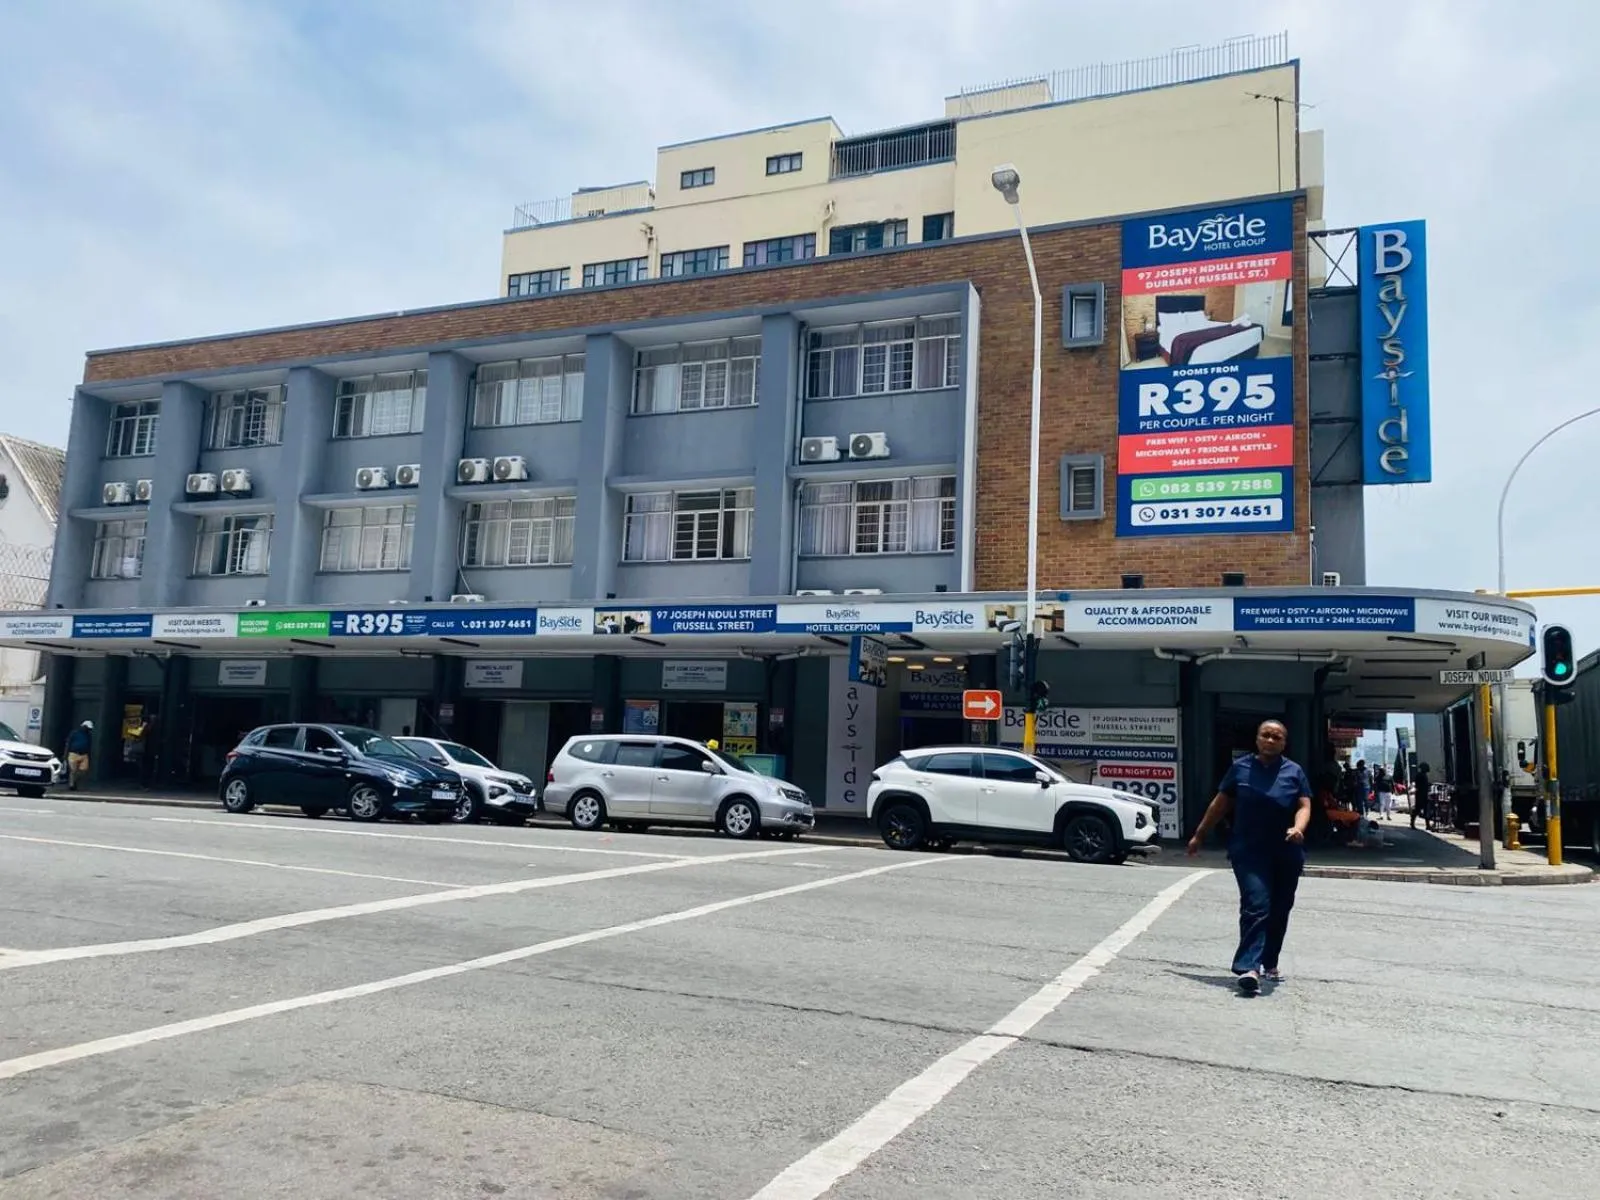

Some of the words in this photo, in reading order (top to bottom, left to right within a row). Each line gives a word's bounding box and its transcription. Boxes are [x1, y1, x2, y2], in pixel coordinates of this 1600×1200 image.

[1149, 214, 1266, 252] Bayside
[1204, 242, 1231, 251] HOTEL
[1234, 238, 1266, 248] GROUP
[1138, 271, 1152, 280] 97
[1154, 267, 1196, 279] JOSEPH
[1199, 263, 1234, 273] NDULI
[1236, 258, 1277, 270] STREET
[1145, 278, 1192, 289] DURBAN
[1195, 271, 1246, 285] (RUSSELL
[1248, 269, 1269, 280] ST.)
[1372, 229, 1414, 475] Bayside
[1173, 367, 1208, 377] ROOMS
[1210, 365, 1239, 375] FROM
[1138, 374, 1276, 417] R395
[1140, 420, 1160, 429] PER
[1213, 416, 1234, 425] PER
[1237, 412, 1275, 423] NIGHT
[1146, 437, 1167, 446] FREE
[1168, 436, 1188, 445] WIFI
[1195, 434, 1217, 444] DSTV
[1225, 433, 1260, 442] AIRCON
[1136, 448, 1191, 458] MICROWAVE
[1197, 445, 1230, 455] FRIDGE
[1231, 445, 1238, 454] &
[1240, 443, 1272, 453] KETTLE
[1171, 458, 1196, 468] 24HR
[1197, 456, 1240, 467] SECURITY
[1160, 483, 1190, 495] 082
[1195, 481, 1226, 493] 539
[1231, 478, 1273, 492] 7588
[1160, 507, 1189, 520] 031
[1195, 506, 1226, 518] 307
[1230, 504, 1272, 517] 4651
[657, 611, 669, 620] 97
[670, 611, 705, 620] JOSEPH
[707, 610, 738, 620] NDULI
[739, 609, 773, 619] STREET
[826, 609, 861, 621] Bayside
[1084, 607, 1128, 616] QUALITY
[1131, 607, 1140, 615] &
[1142, 605, 1213, 615] AFFORDABLE
[1260, 607, 1280, 615] WIFI
[1287, 607, 1309, 615] DSTV
[1316, 607, 1350, 615] AIRCON
[1357, 607, 1409, 616] MICROWAVE
[346, 613, 404, 634] R395
[539, 616, 582, 630] Bayside
[915, 610, 974, 629] Bayside
[1097, 616, 1198, 626] ACCOMMODATION
[1331, 616, 1355, 624] 24HR
[1356, 616, 1395, 624] SECURITY
[1446, 609, 1469, 619] VISIT
[1471, 611, 1490, 621] OUR
[1490, 614, 1519, 626] WEBSITE
[469, 620, 486, 629] 031
[488, 620, 506, 629] 307
[507, 620, 532, 629] 4651
[672, 621, 714, 631] (RUSSELL
[717, 621, 754, 631] STREET)
[806, 624, 833, 632] HOTEL
[834, 623, 881, 632] RECEPTION
[911, 671, 964, 687] Baysi
[1443, 671, 1474, 683] JOSEPH
[1478, 671, 1502, 682] NDULI
[843, 687, 861, 803] ayside
[1058, 748, 1090, 757] LUXURY
[1092, 750, 1174, 759] ACCOMMODATION
[1101, 767, 1123, 776] OVER
[1125, 768, 1150, 776] NIGHT
[1152, 769, 1173, 777] STAY
